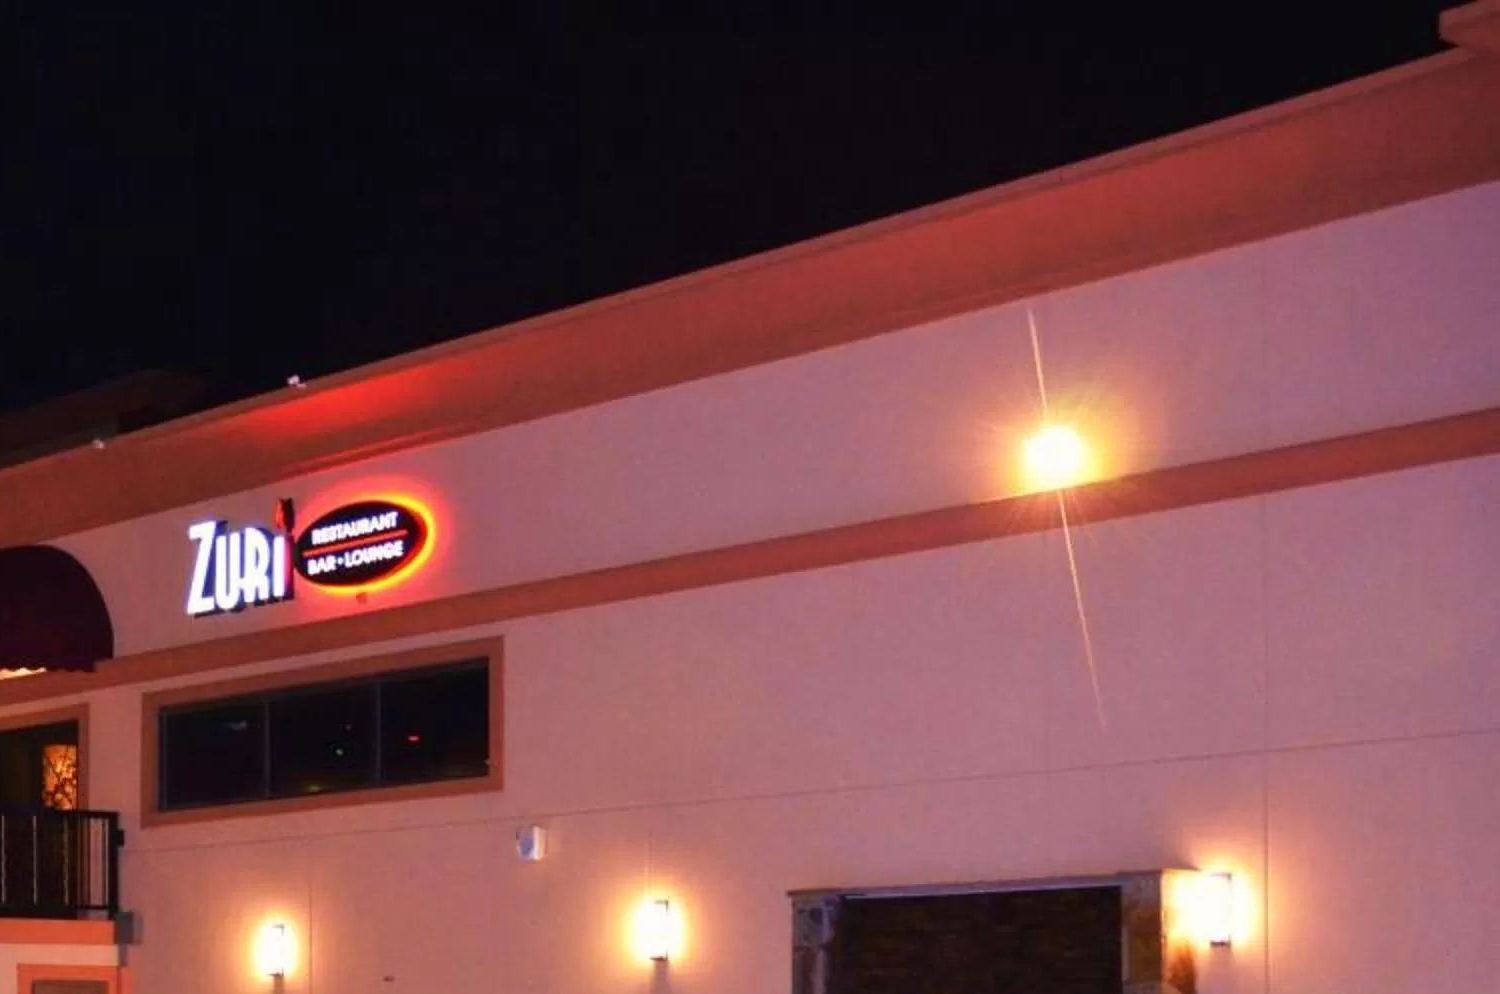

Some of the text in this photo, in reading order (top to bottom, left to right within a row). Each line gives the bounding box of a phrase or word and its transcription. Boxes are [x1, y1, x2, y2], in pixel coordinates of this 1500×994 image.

[311, 511, 398, 545] RESTAURANT
[307, 540, 403, 575] BAR LOUNGE
